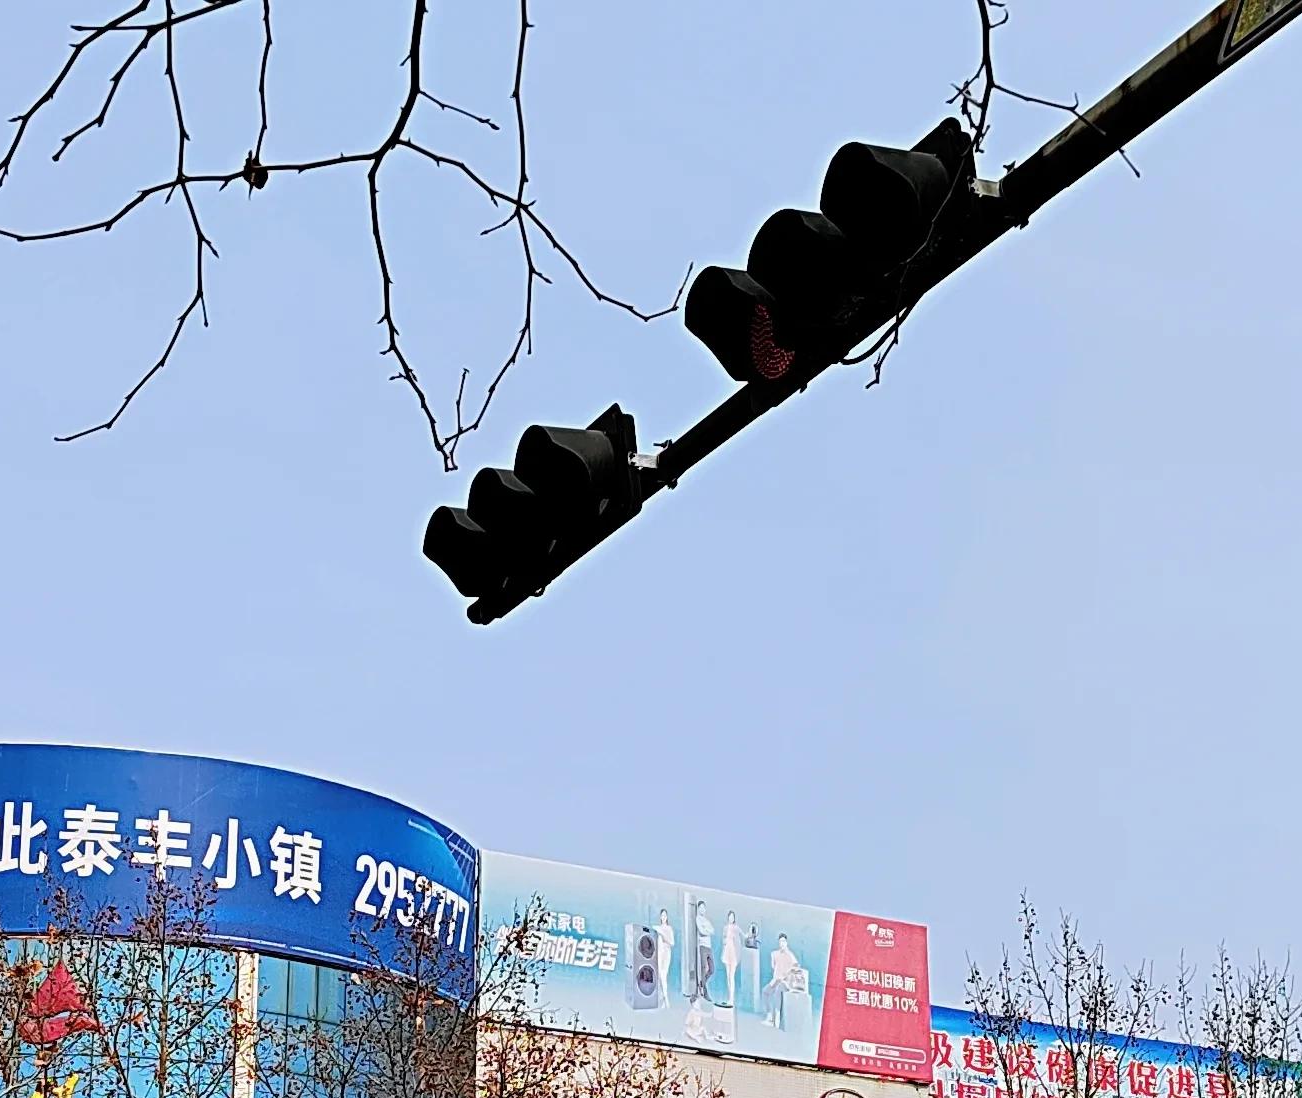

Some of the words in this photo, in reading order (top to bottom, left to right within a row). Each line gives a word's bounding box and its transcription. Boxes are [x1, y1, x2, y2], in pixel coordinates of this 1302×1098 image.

[845, 967, 916, 993] 家电以旧换新
